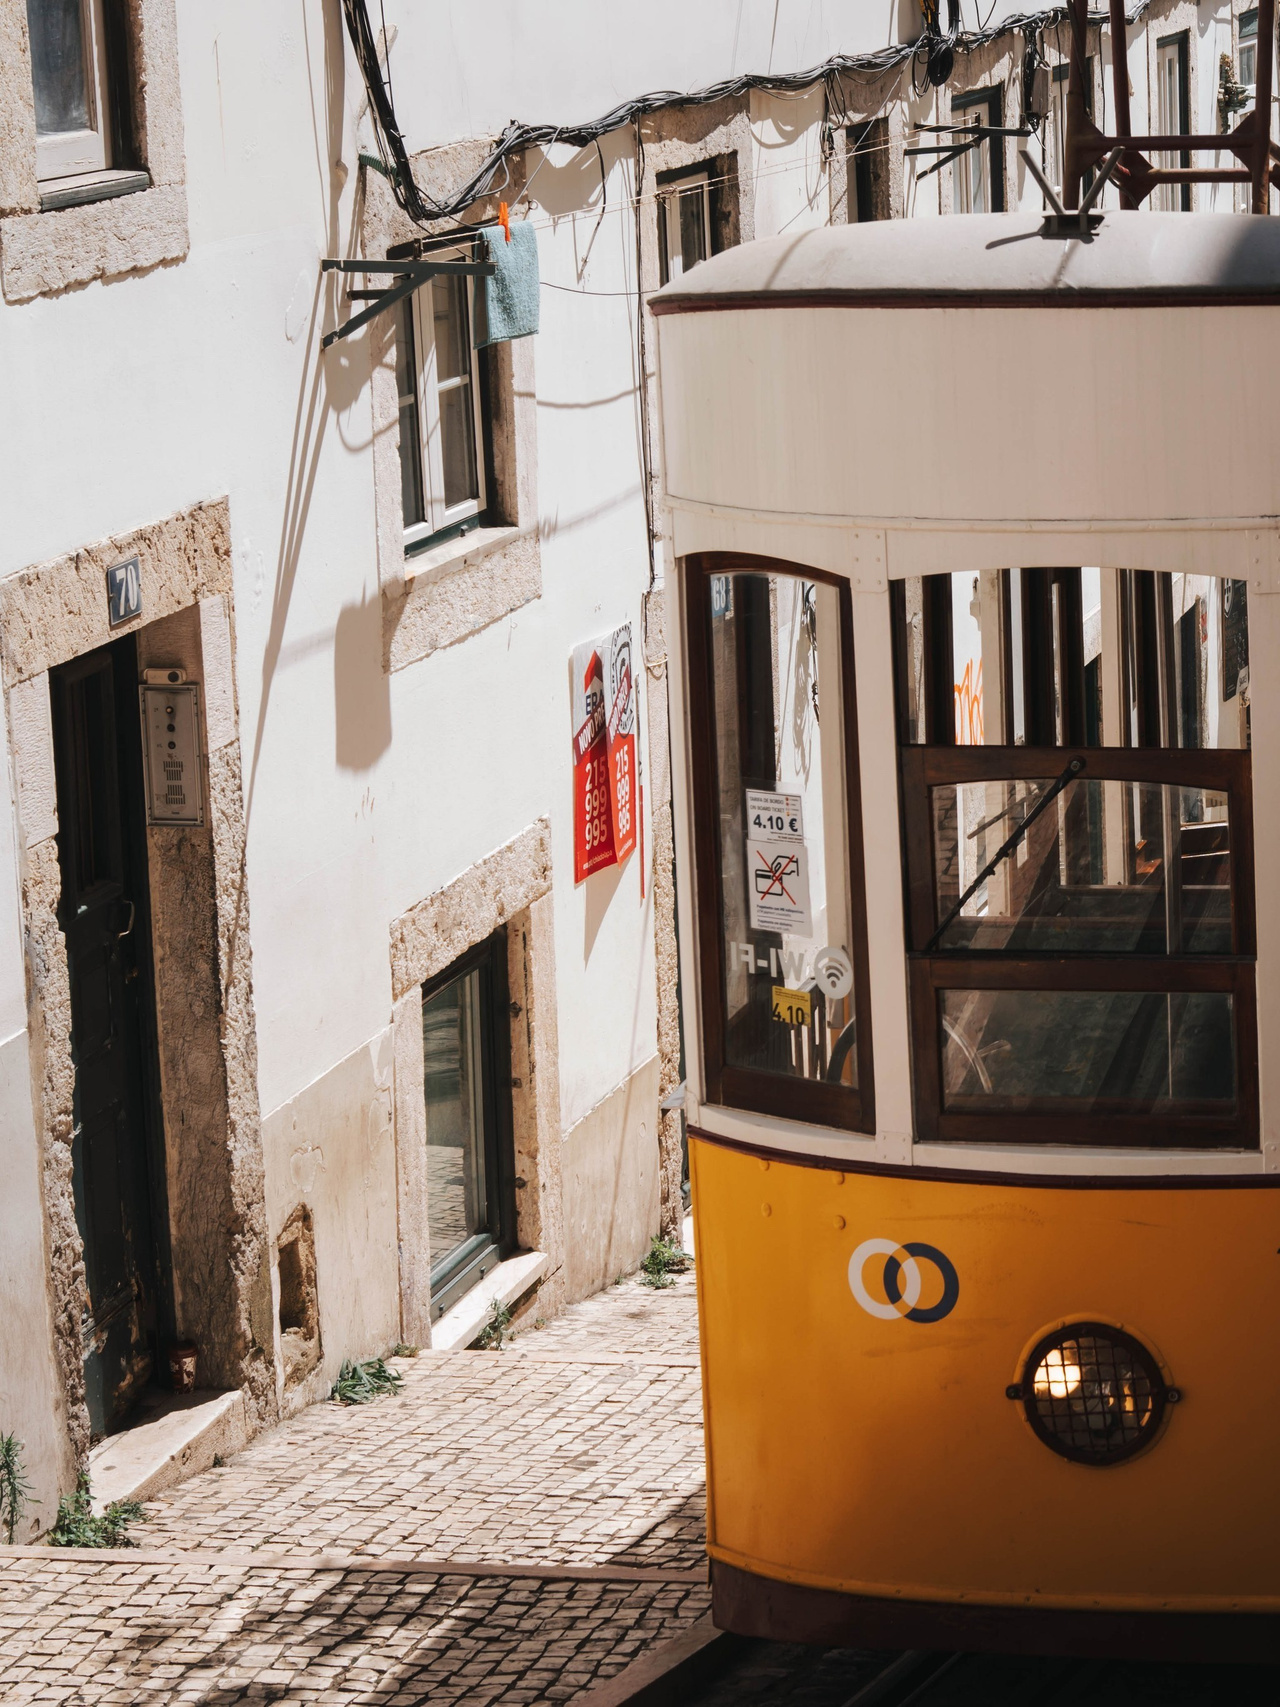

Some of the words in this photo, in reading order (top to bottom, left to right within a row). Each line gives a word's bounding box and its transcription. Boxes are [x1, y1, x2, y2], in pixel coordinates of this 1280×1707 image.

[115, 565, 138, 617] 70
[586, 689, 605, 716] ERA
[578, 718, 595, 756] NOVO
[594, 701, 606, 732] PRE
[585, 755, 607, 792] 215
[615, 744, 629, 781] 215
[585, 785, 607, 821] 999
[616, 774, 630, 810] 999
[585, 814, 607, 851] 995
[618, 802, 631, 839] 995
[753, 814, 784, 831] 4.10
[788, 818, 798, 832] €
